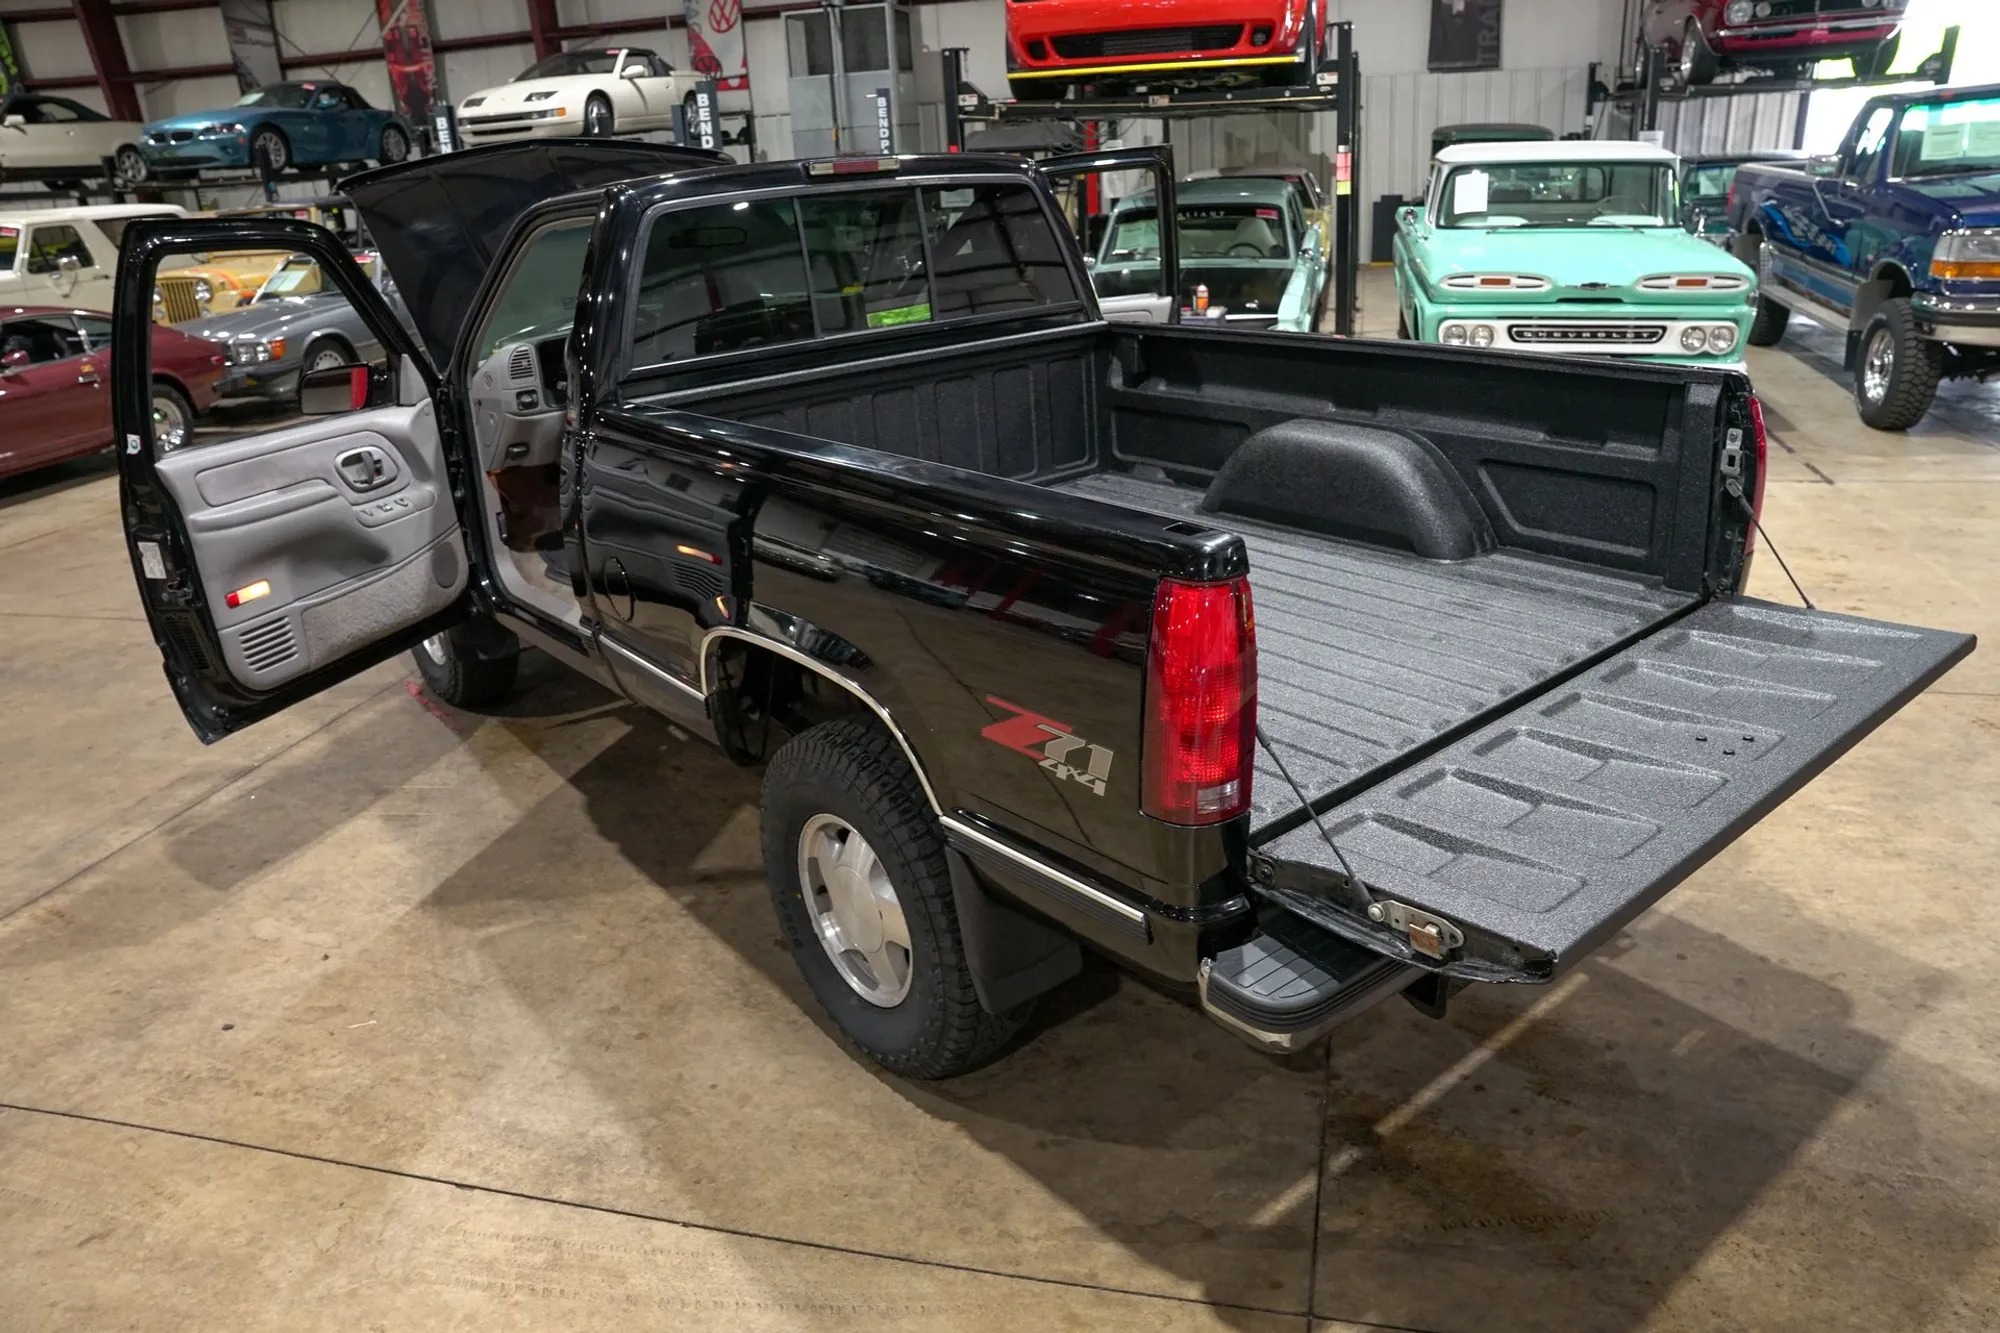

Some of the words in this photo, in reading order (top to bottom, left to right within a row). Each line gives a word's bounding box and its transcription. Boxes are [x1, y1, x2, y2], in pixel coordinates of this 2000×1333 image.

[1476, 0, 1498, 62] TRA
[435, 116, 453, 155] BEN
[696, 93, 714, 149] BEND
[1176, 211, 1226, 220] ALIANT
[1523, 331, 1650, 339] CHEVROLET
[981, 695, 1114, 781] Z71
